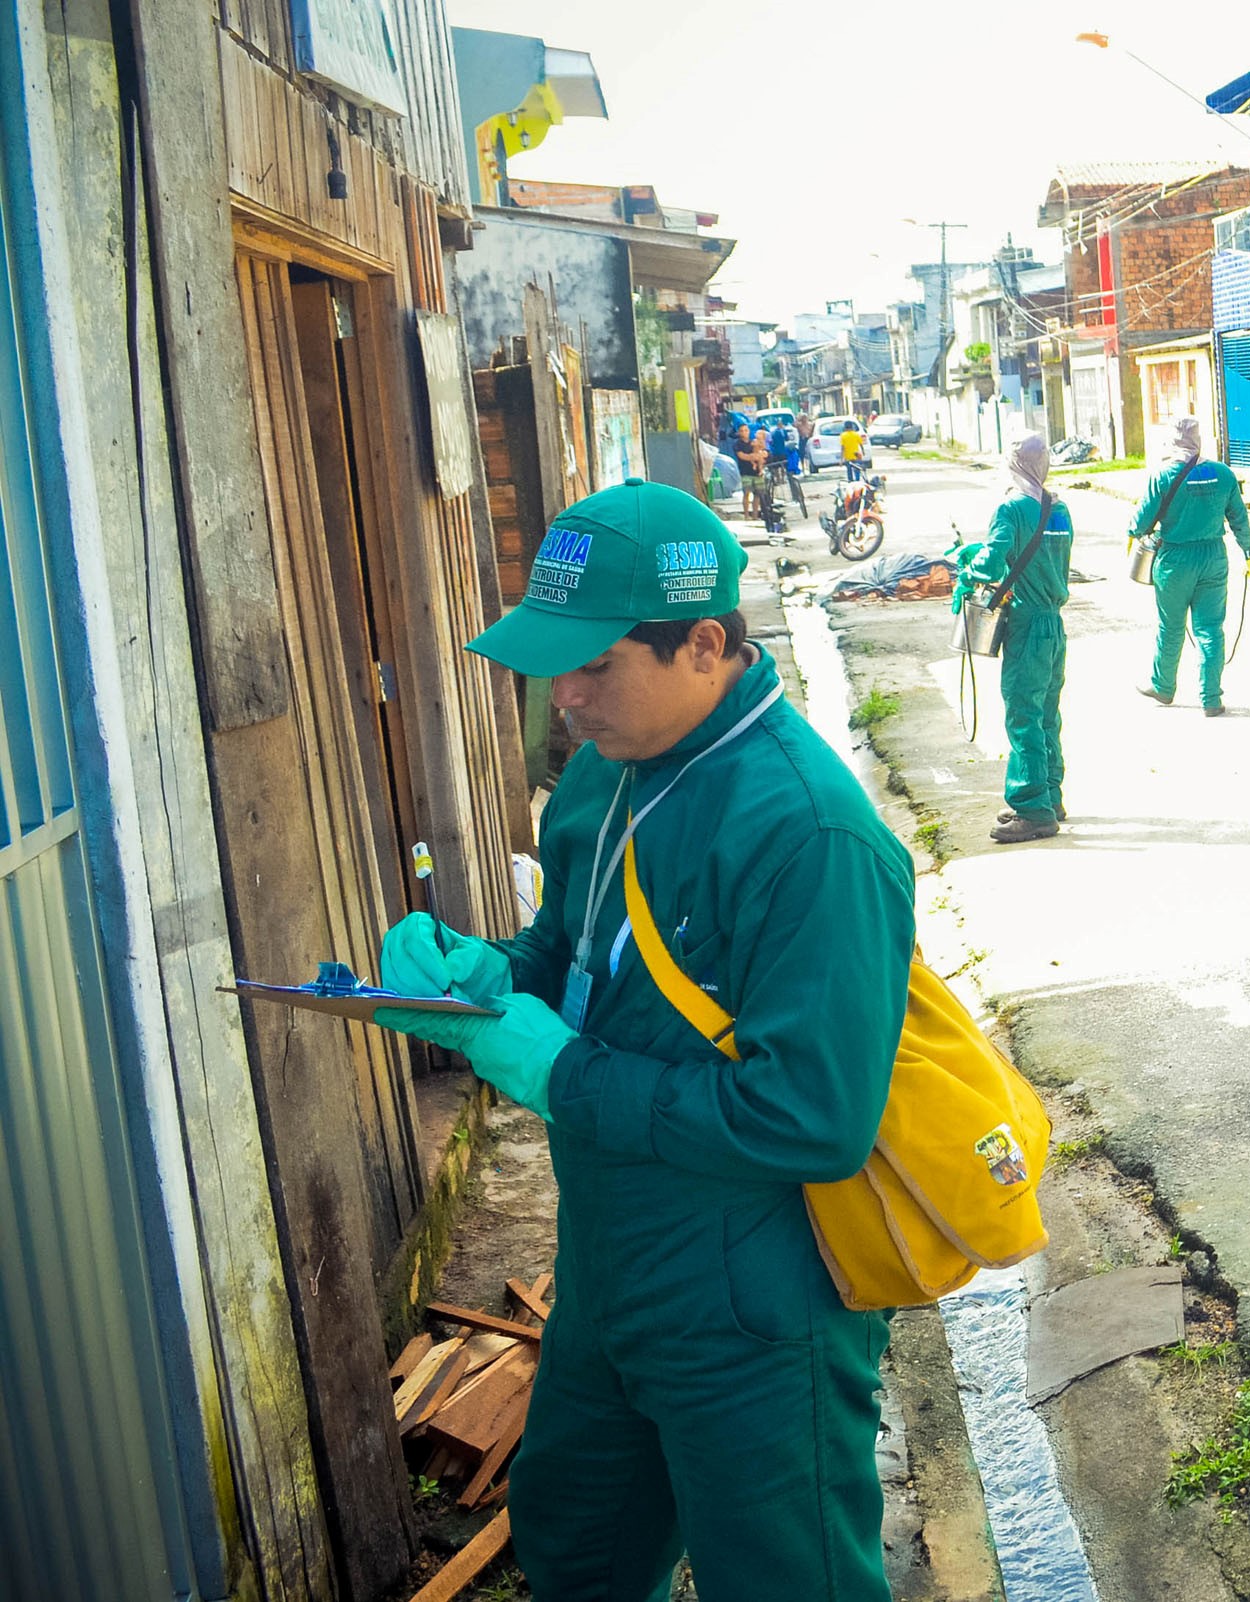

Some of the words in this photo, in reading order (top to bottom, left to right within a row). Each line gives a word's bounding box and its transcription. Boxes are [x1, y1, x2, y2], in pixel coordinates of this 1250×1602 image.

[656, 541, 719, 572] SESMA
[563, 572, 579, 589] DE
[660, 576, 706, 590] CONTROLE
[705, 575, 717, 587] DE
[667, 589, 712, 603] ENDEMIAS
